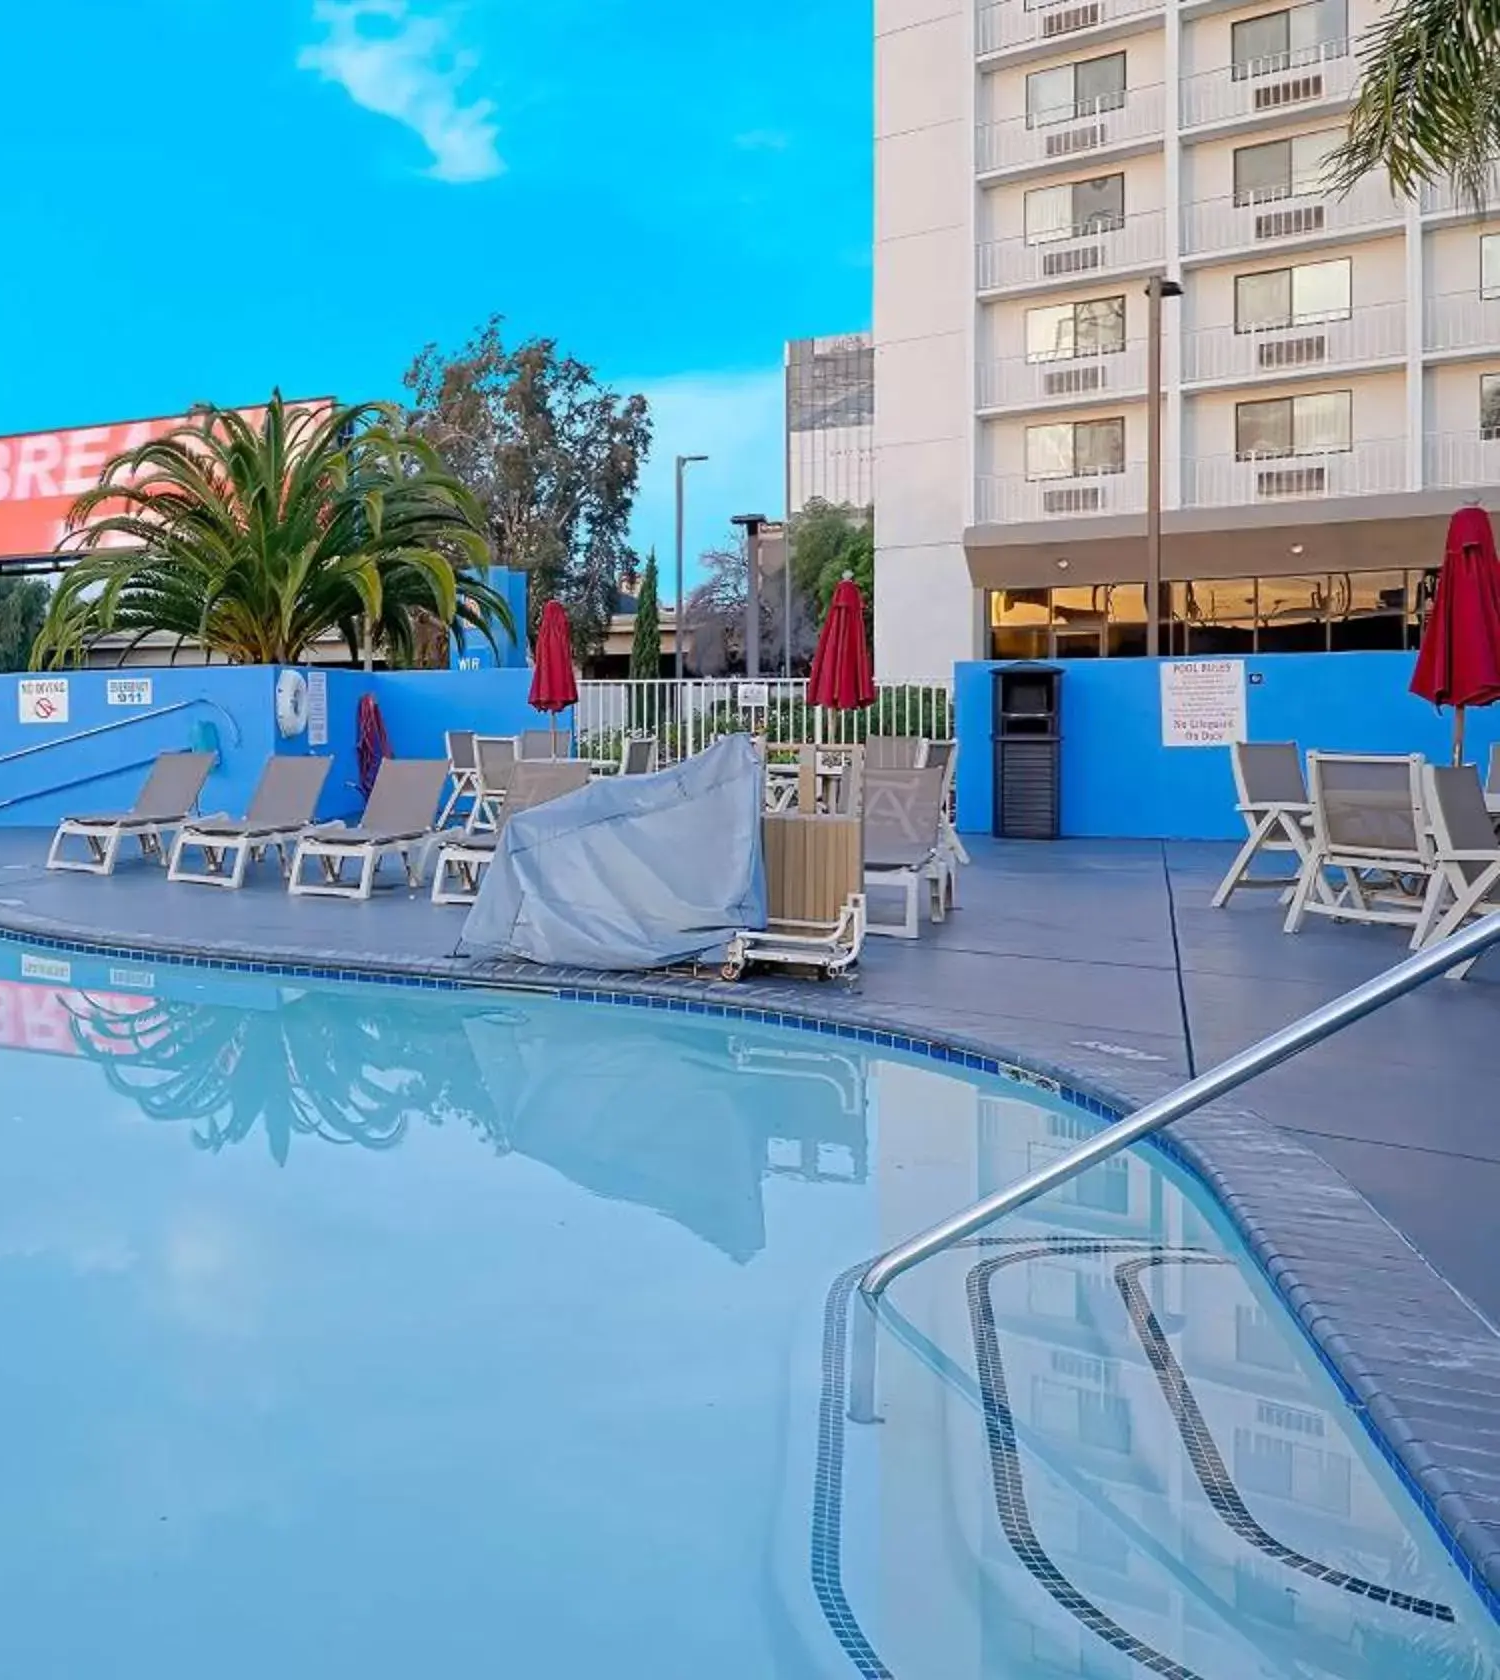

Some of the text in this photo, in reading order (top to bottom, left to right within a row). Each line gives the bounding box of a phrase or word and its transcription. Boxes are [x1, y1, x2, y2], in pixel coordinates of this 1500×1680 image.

[1173, 663, 1231, 673] POOL RULES
[21, 684, 33, 694] NO
[117, 693, 142, 702] 911
